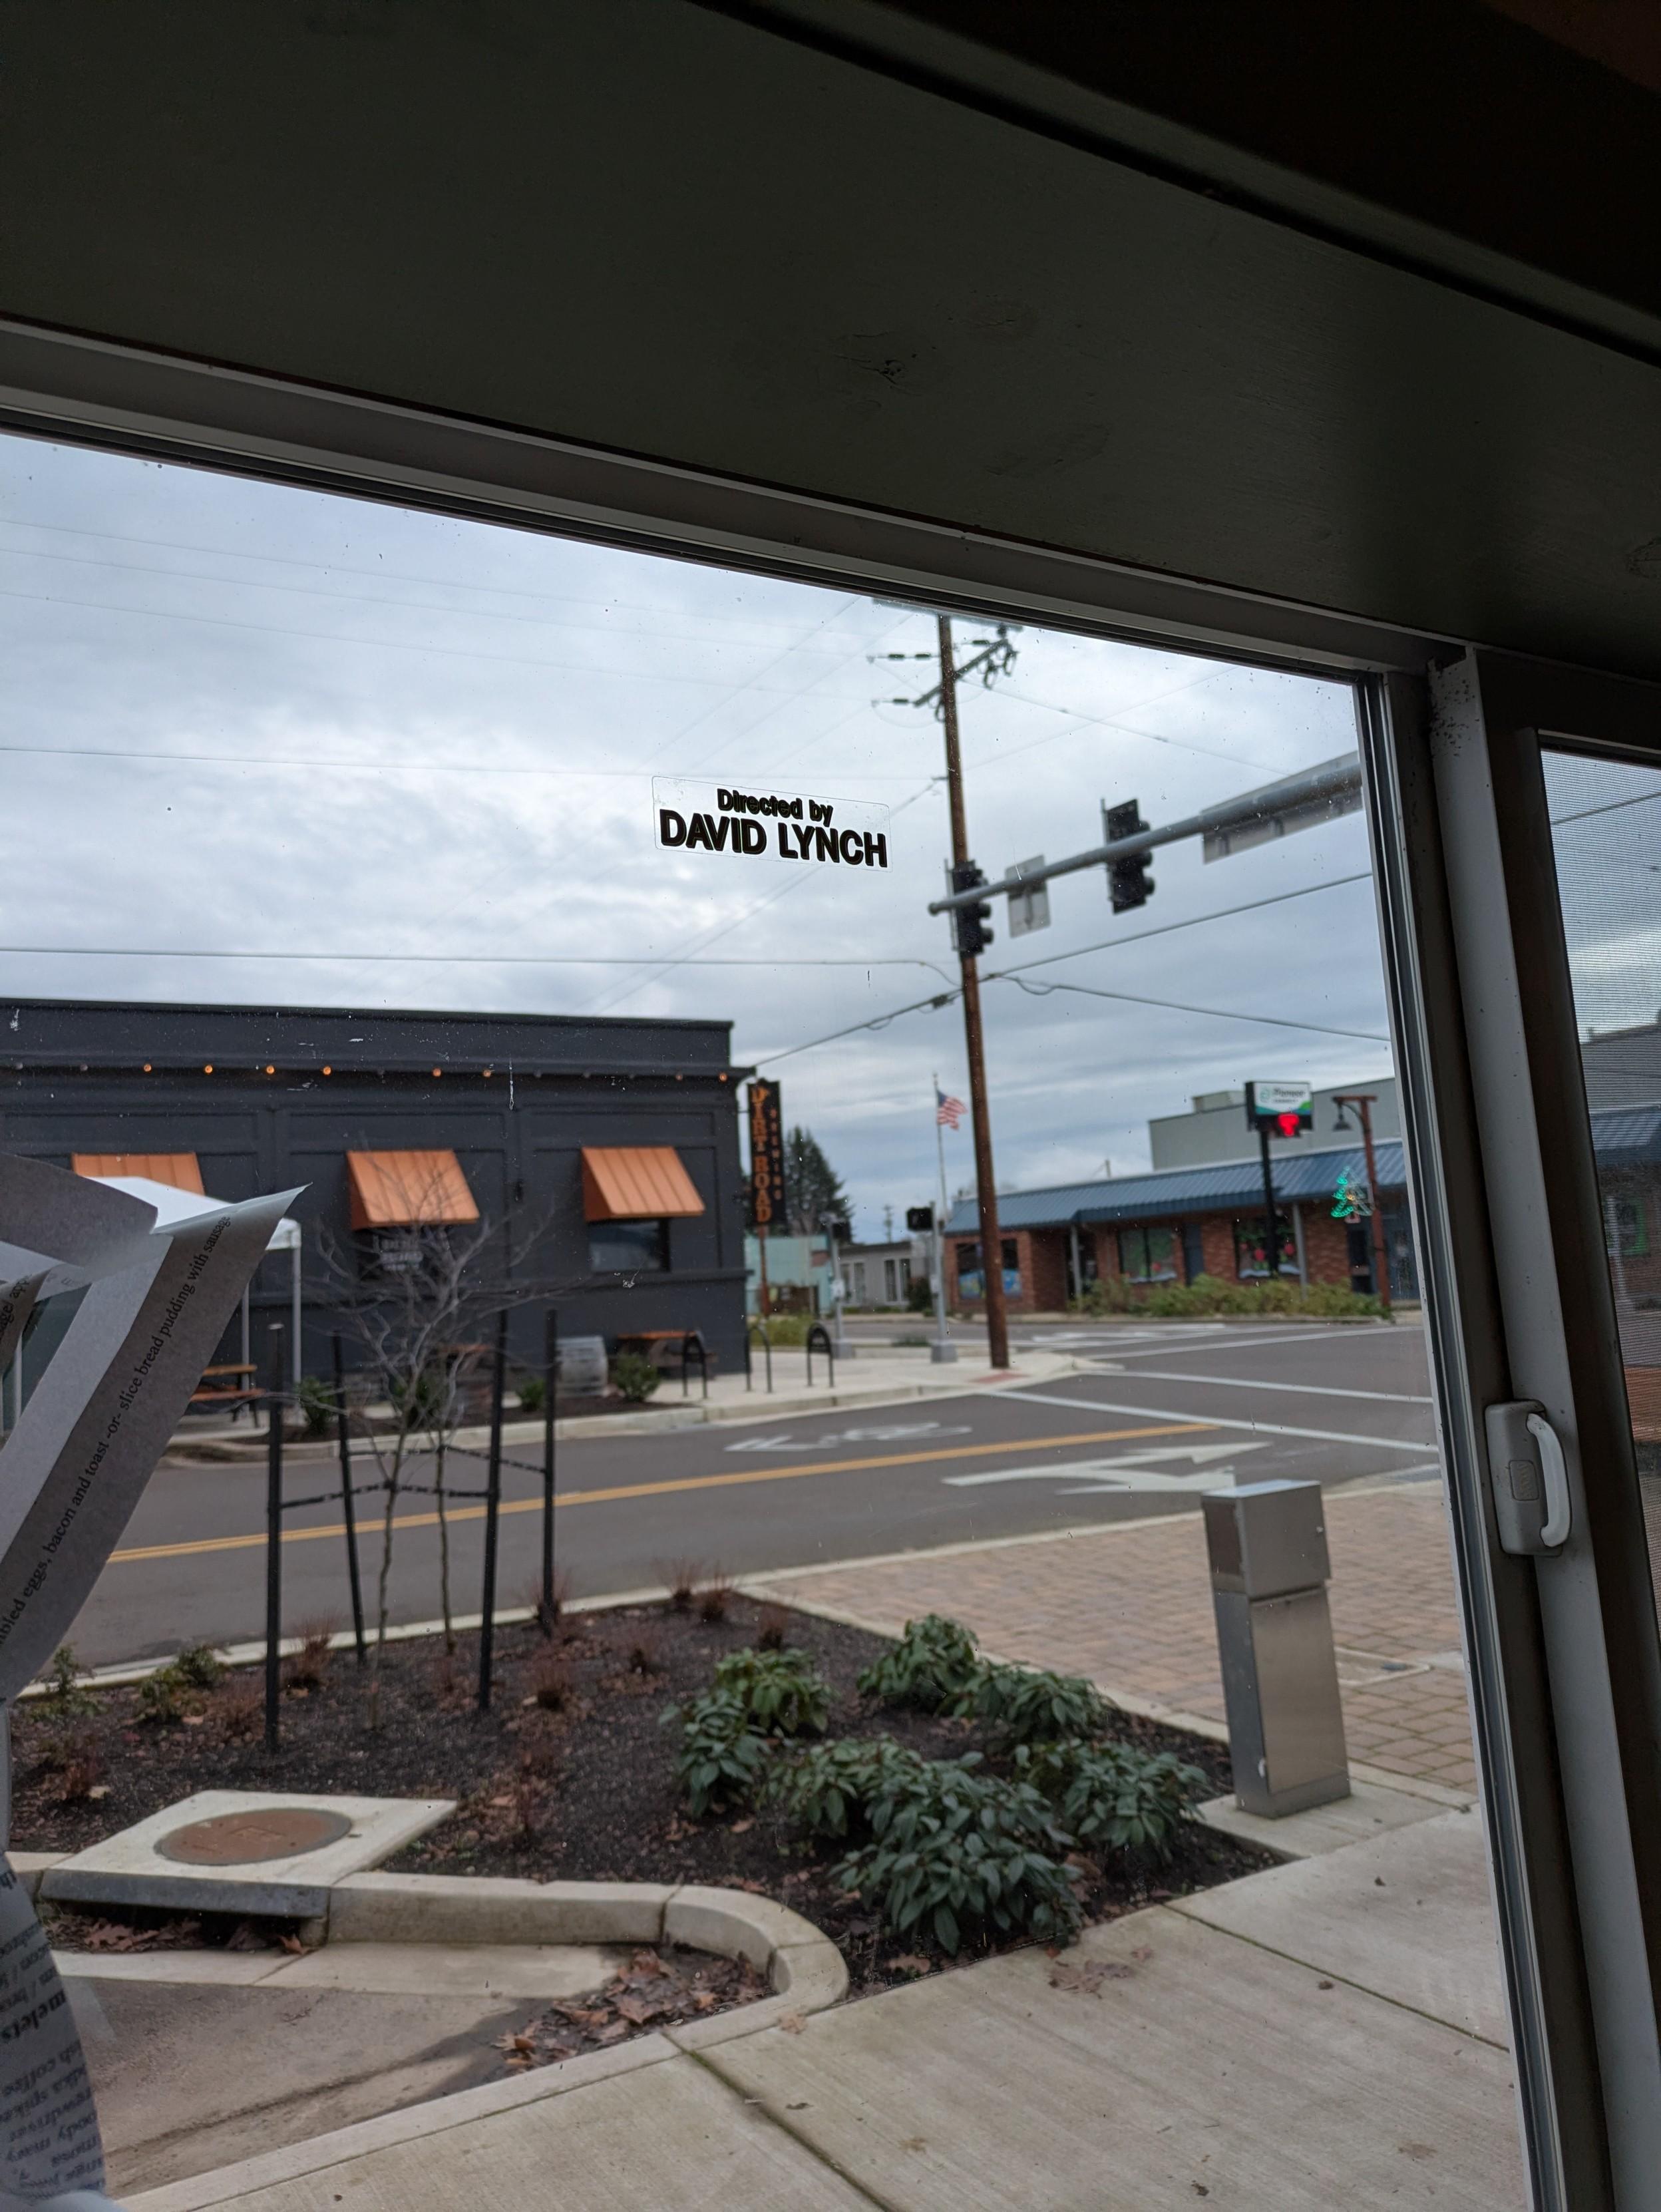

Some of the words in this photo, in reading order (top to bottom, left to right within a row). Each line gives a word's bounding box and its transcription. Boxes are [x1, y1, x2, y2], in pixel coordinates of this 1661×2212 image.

[717, 788, 803, 819] Directed
[809, 799, 833, 827] by
[659, 809, 767, 855] DAVID
[777, 823, 888, 867] LYNCH
[23, 1559, 52, 1597] eggs,
[43, 1508, 77, 1554] bacon
[72, 1477, 91, 1507] and
[85, 1441, 109, 1477] toast
[106, 1413, 121, 1439] -or-
[120, 1378, 142, 1410] slice
[134, 1336, 164, 1376] bread
[160, 1284, 195, 1338] pudding
[188, 1254, 209, 1280] with
